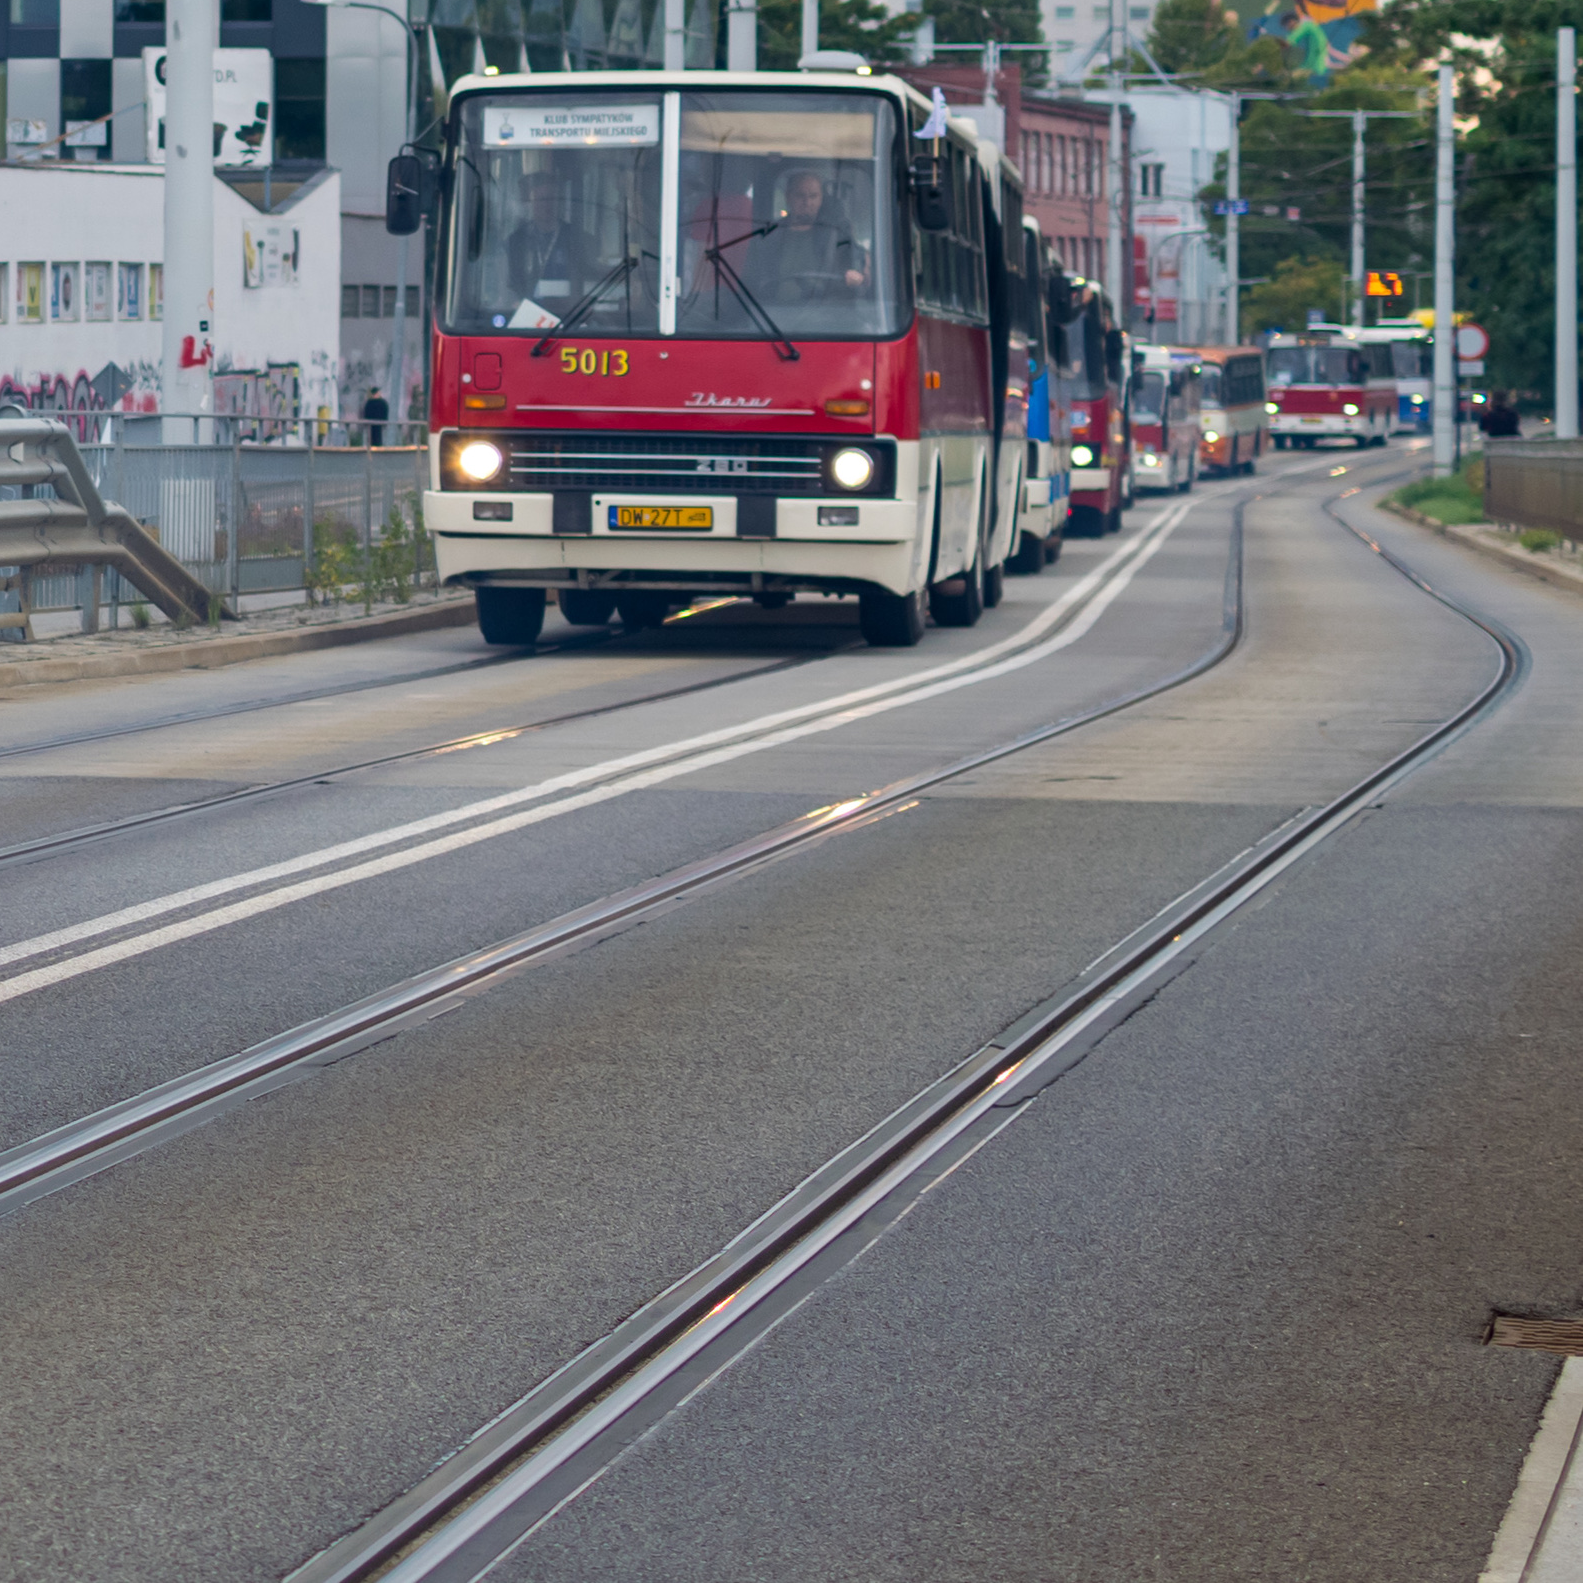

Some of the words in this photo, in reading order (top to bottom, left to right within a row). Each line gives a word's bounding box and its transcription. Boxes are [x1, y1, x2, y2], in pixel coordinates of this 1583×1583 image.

[544, 114, 569, 124] KLUB
[571, 113, 634, 123] SYMPATYKÓW
[530, 127, 591, 137] TRANSPORTU
[593, 126, 648, 136] MIEJSKIEGO
[560, 346, 630, 377] 5013
[684, 392, 773, 407] Ikarus
[620, 509, 644, 526] DW
[650, 509, 683, 526] 27T
